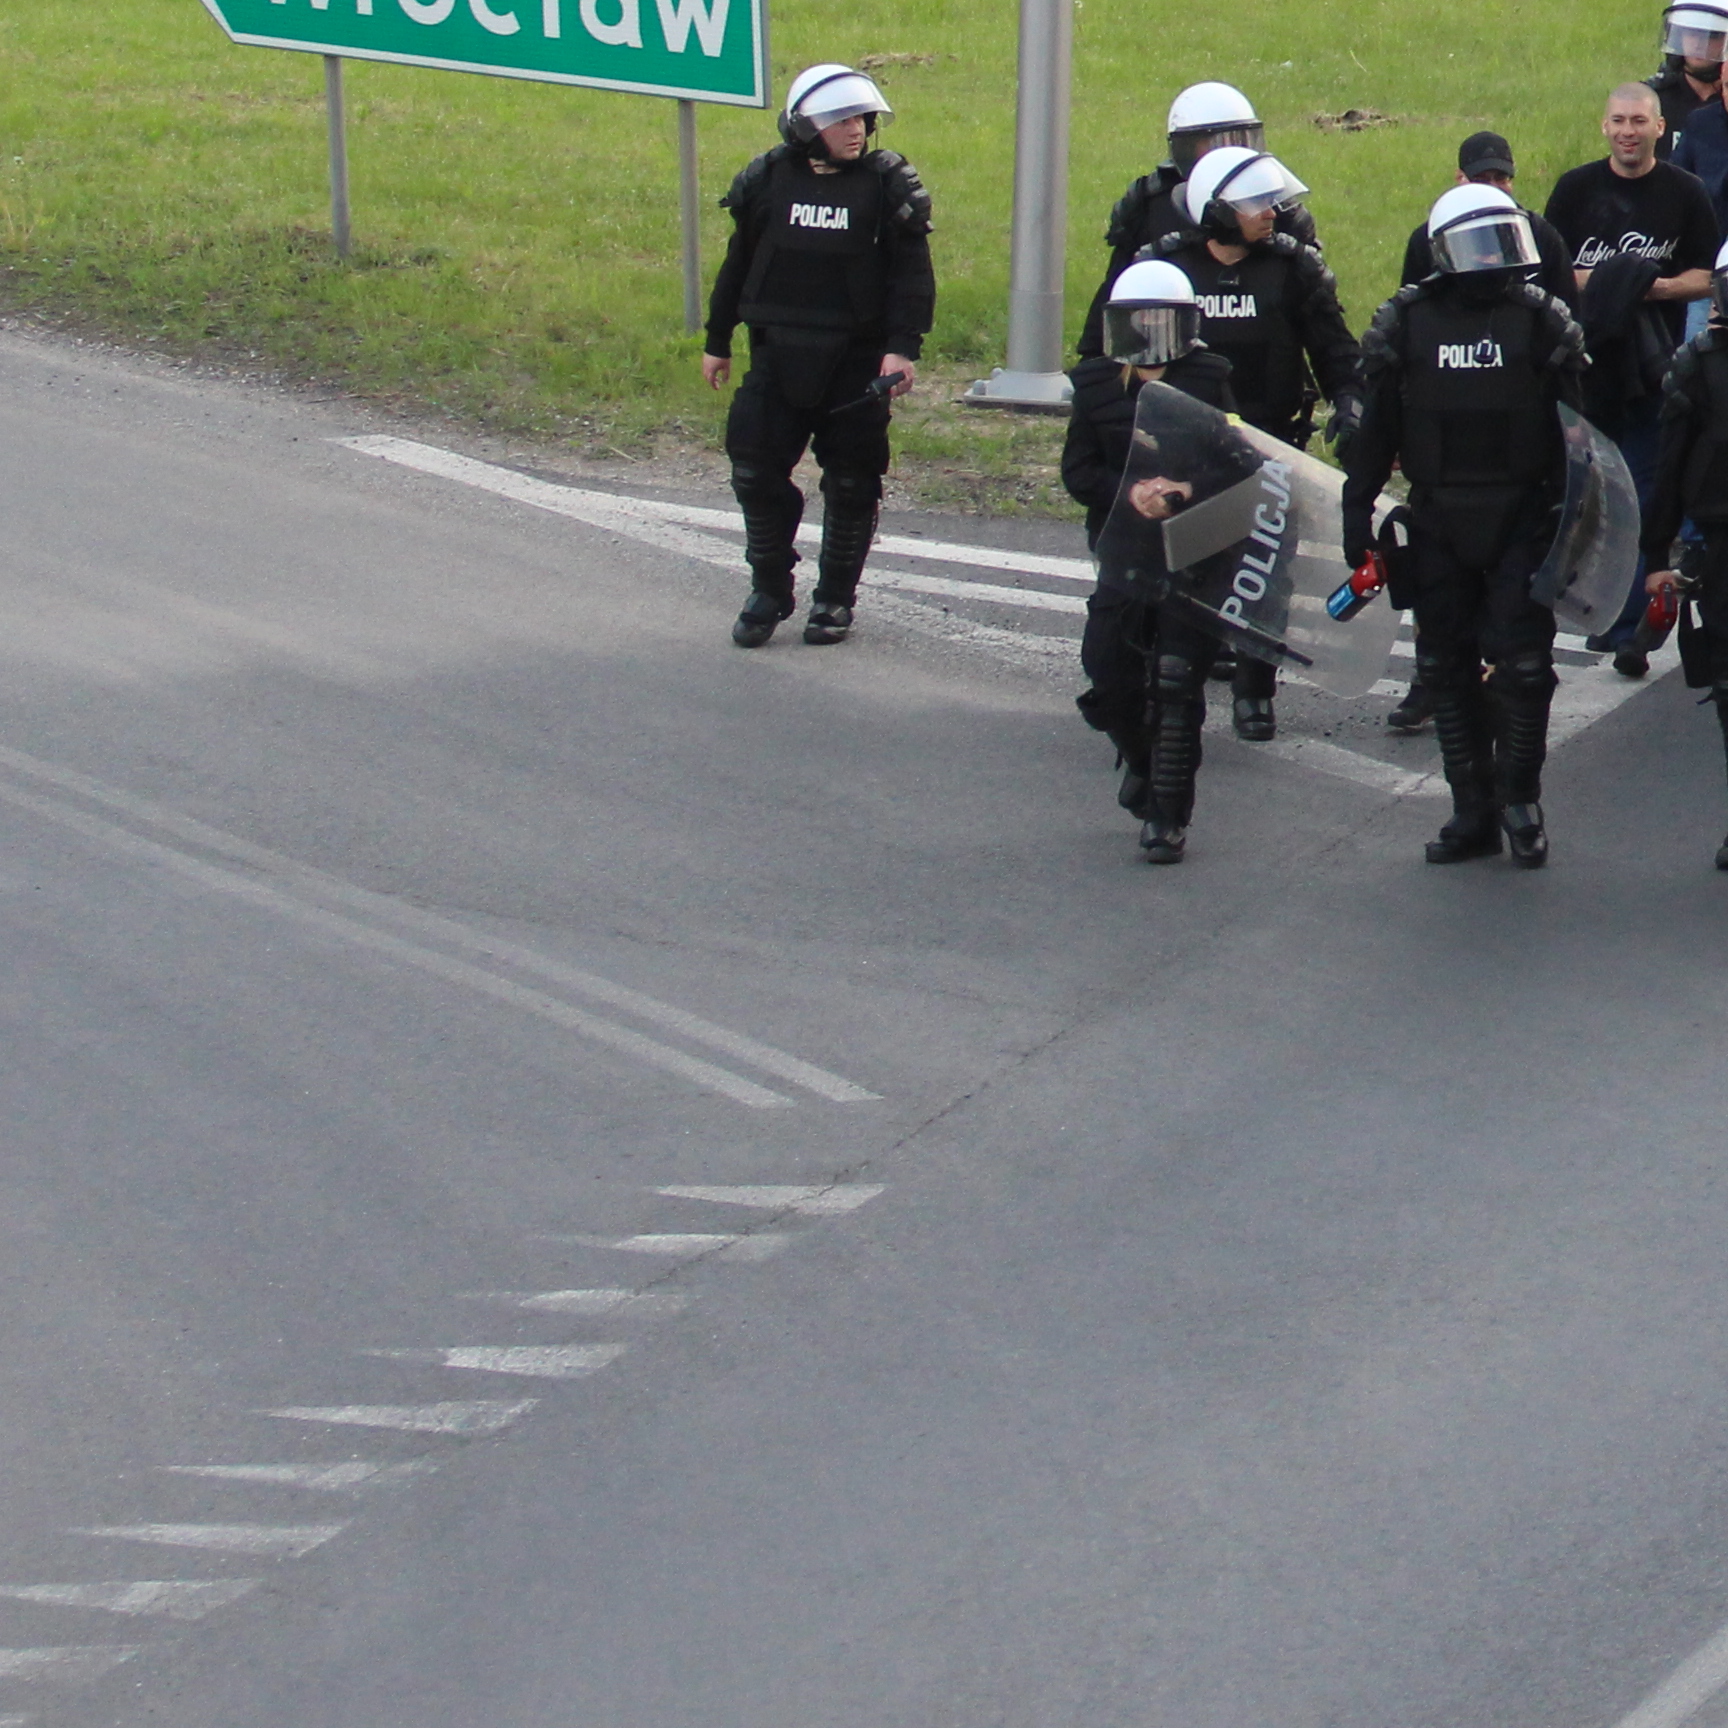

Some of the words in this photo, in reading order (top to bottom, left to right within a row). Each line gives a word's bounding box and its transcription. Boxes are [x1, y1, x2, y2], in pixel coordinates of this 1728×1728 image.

[789, 203, 849, 231] POLICJA
[1194, 294, 1257, 318] POLICJA
[1217, 456, 1294, 630] POLICJA
